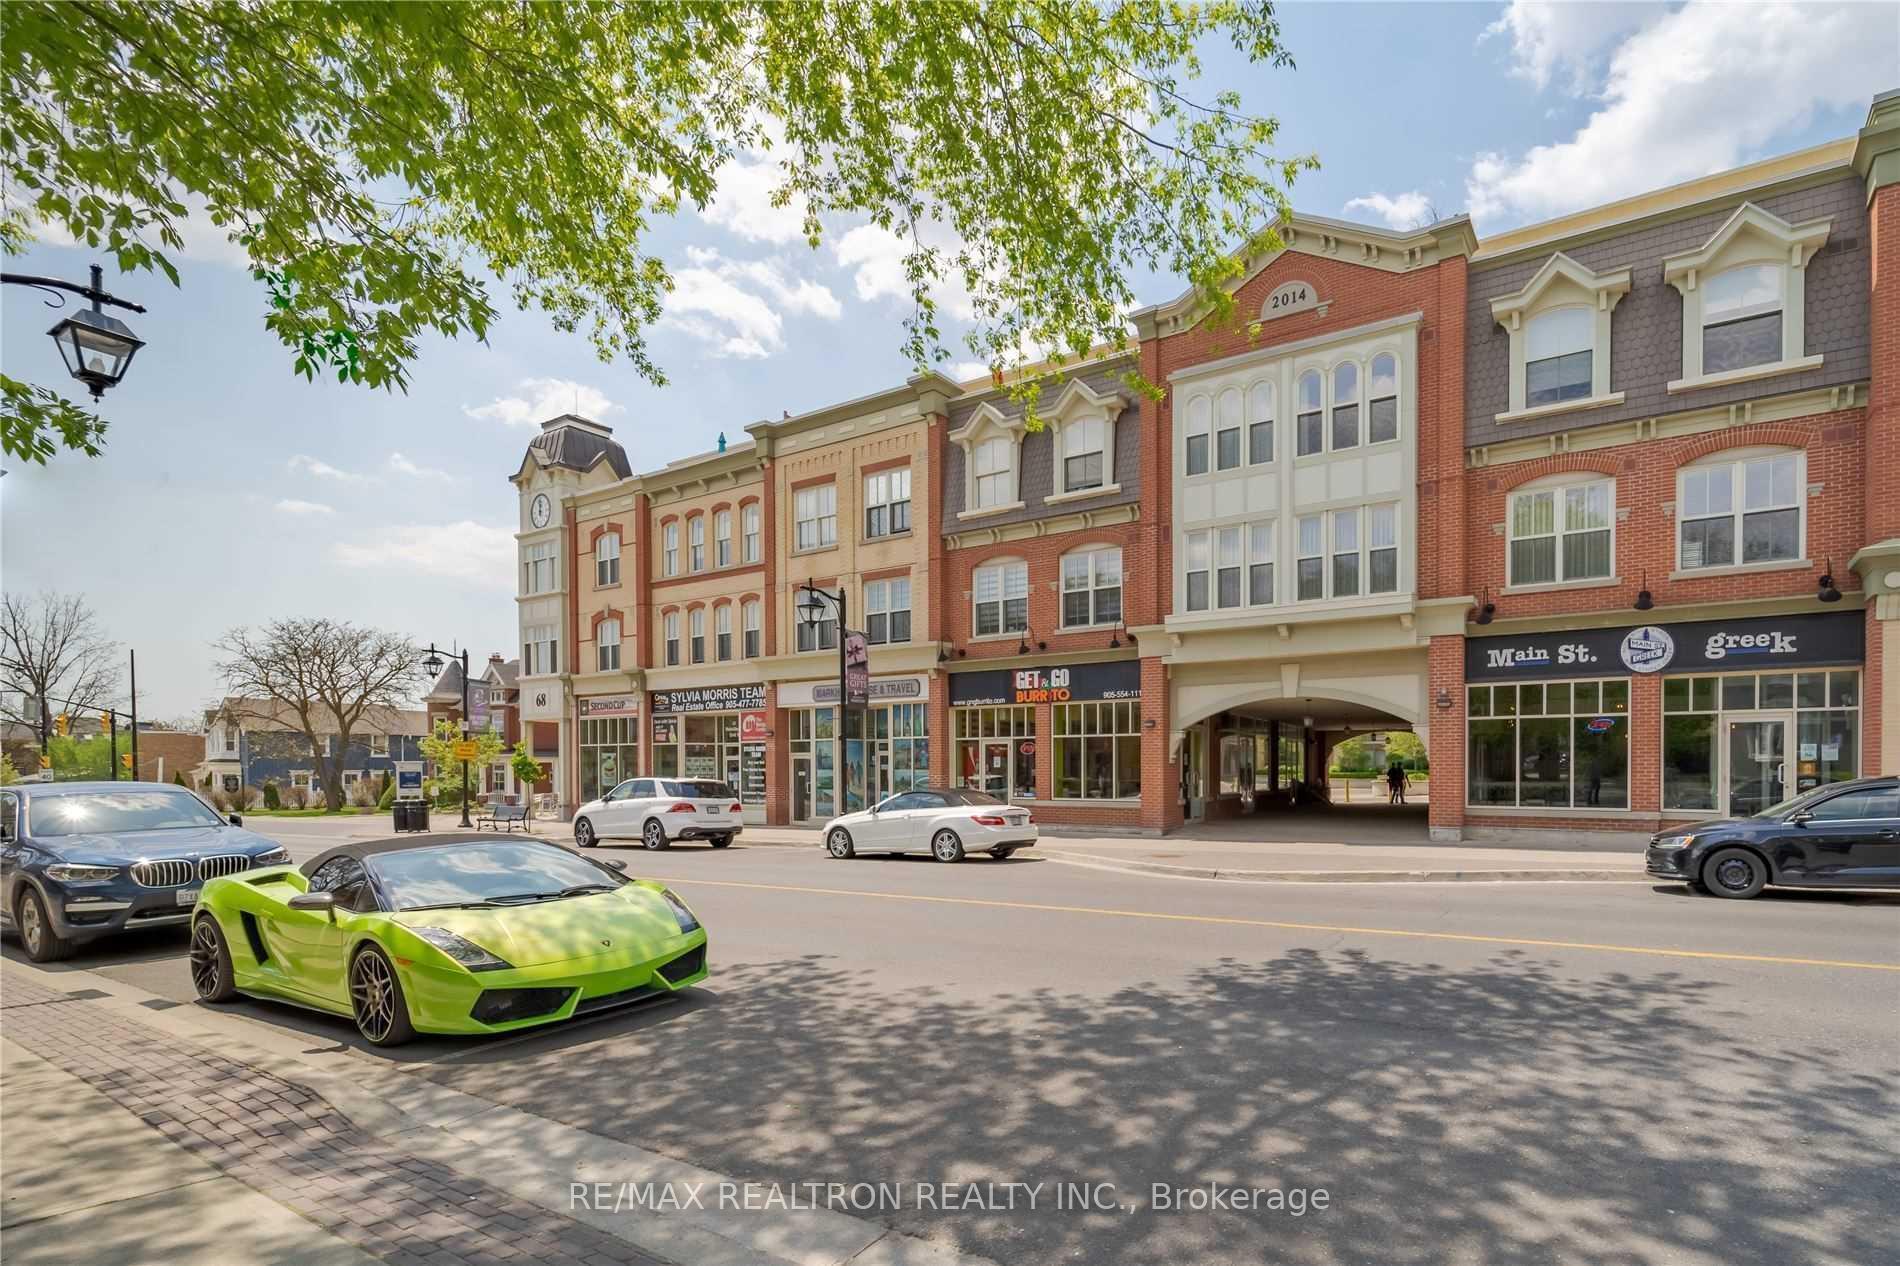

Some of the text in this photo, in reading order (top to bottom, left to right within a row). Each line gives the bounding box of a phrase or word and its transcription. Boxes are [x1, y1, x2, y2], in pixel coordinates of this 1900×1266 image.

[1272, 288, 1306, 308] 2014
[1487, 632, 1797, 668] Main St. greek
[1015, 668, 1070, 689] GET & GO
[671, 690, 701, 703] SYLVIA
[702, 687, 738, 701] MORRIS
[740, 686, 767, 699] TEAM
[815, 688, 842, 698] MARKH
[886, 683, 916, 695] TRAVEL
[1015, 688, 1070, 703] BURRITO
[1103, 690, 1142, 699] 905-554-111
[536, 693, 546, 707] 68
[671, 704, 685, 712] Real
[686, 702, 704, 711] Estate
[705, 700, 724, 710] Office
